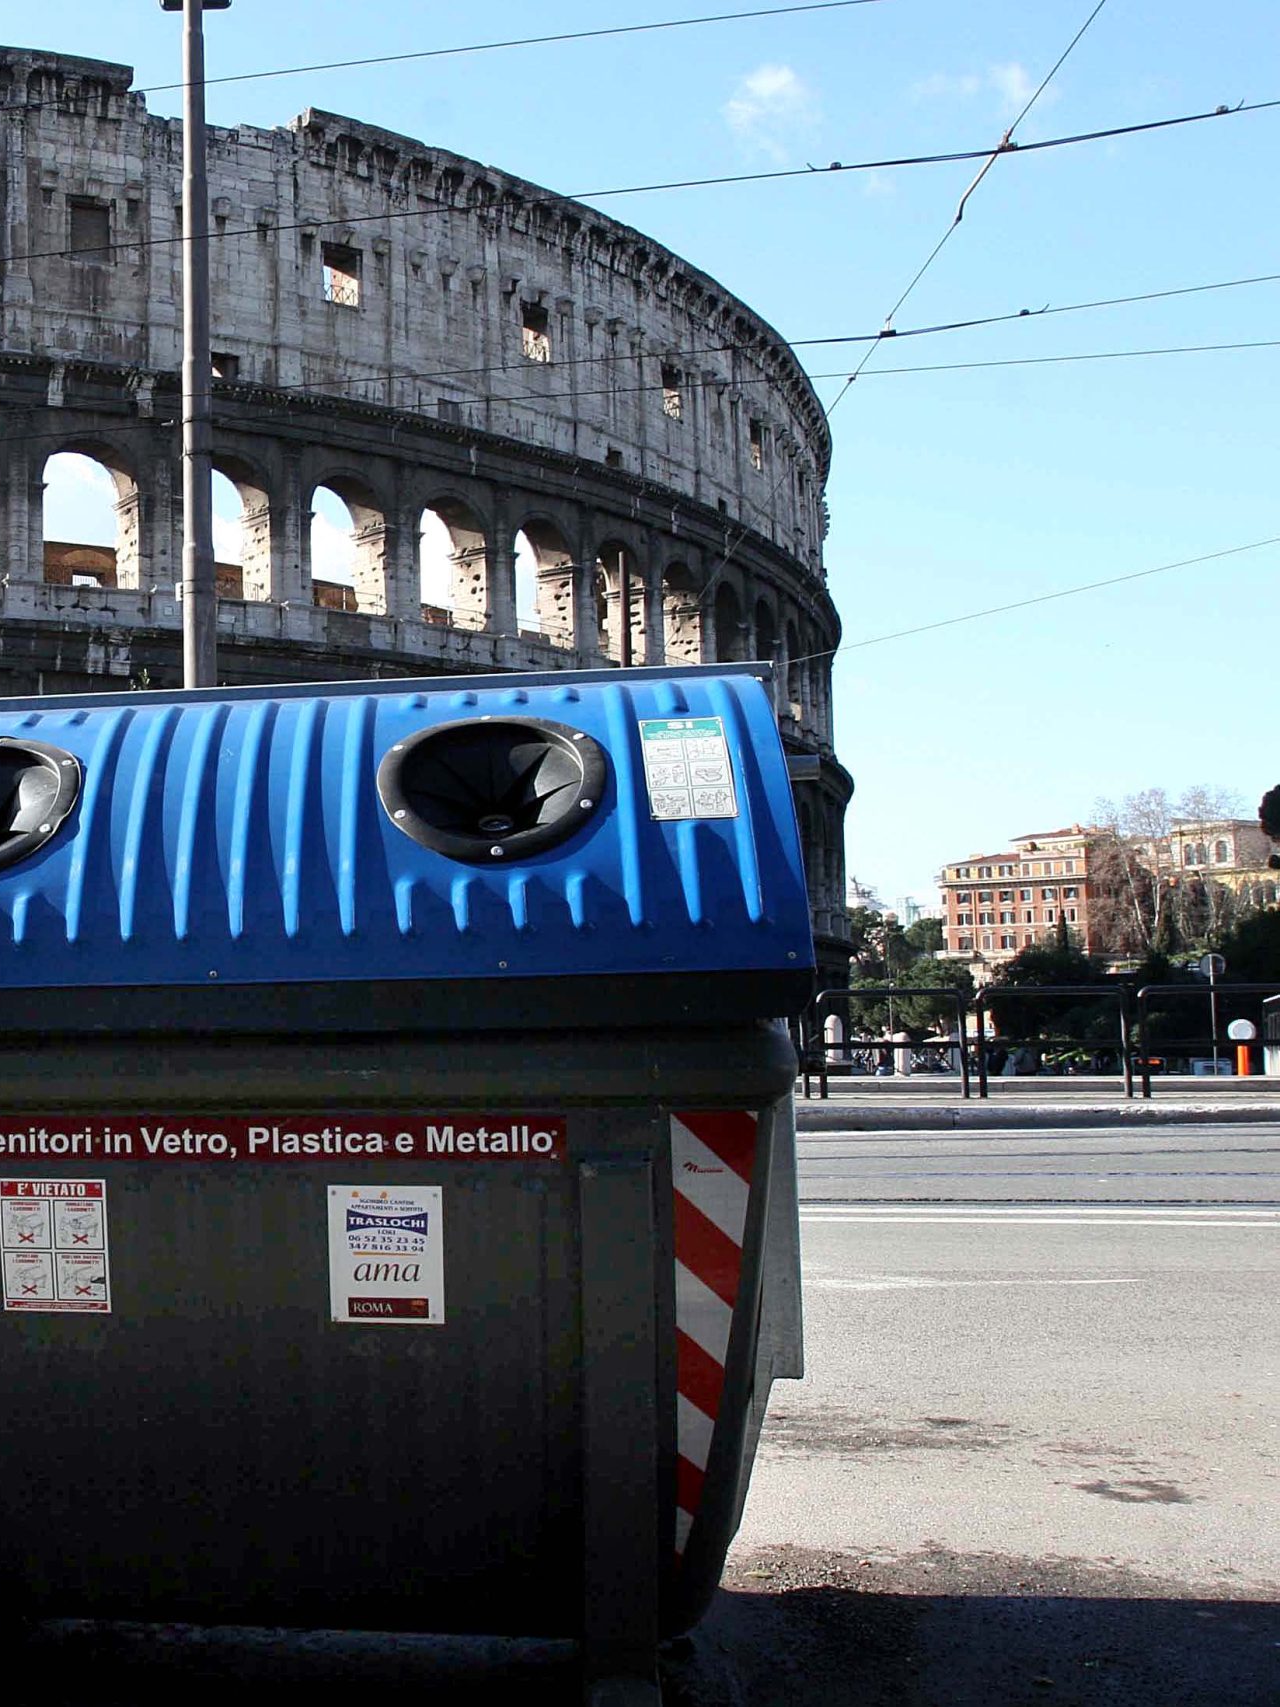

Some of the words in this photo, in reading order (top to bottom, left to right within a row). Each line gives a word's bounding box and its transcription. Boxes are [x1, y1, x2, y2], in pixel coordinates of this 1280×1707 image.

[104, 1127, 132, 1154] in
[141, 1127, 237, 1159] Vetro,
[248, 1126, 384, 1154] Plastica
[394, 1132, 414, 1154] e
[426, 1125, 552, 1153] Metallo
[32, 1183, 86, 1196] VIETATO
[348, 1217, 425, 1228] TRASLOCHI
[353, 1261, 422, 1282] ama
[353, 1302, 393, 1314] ROMA
